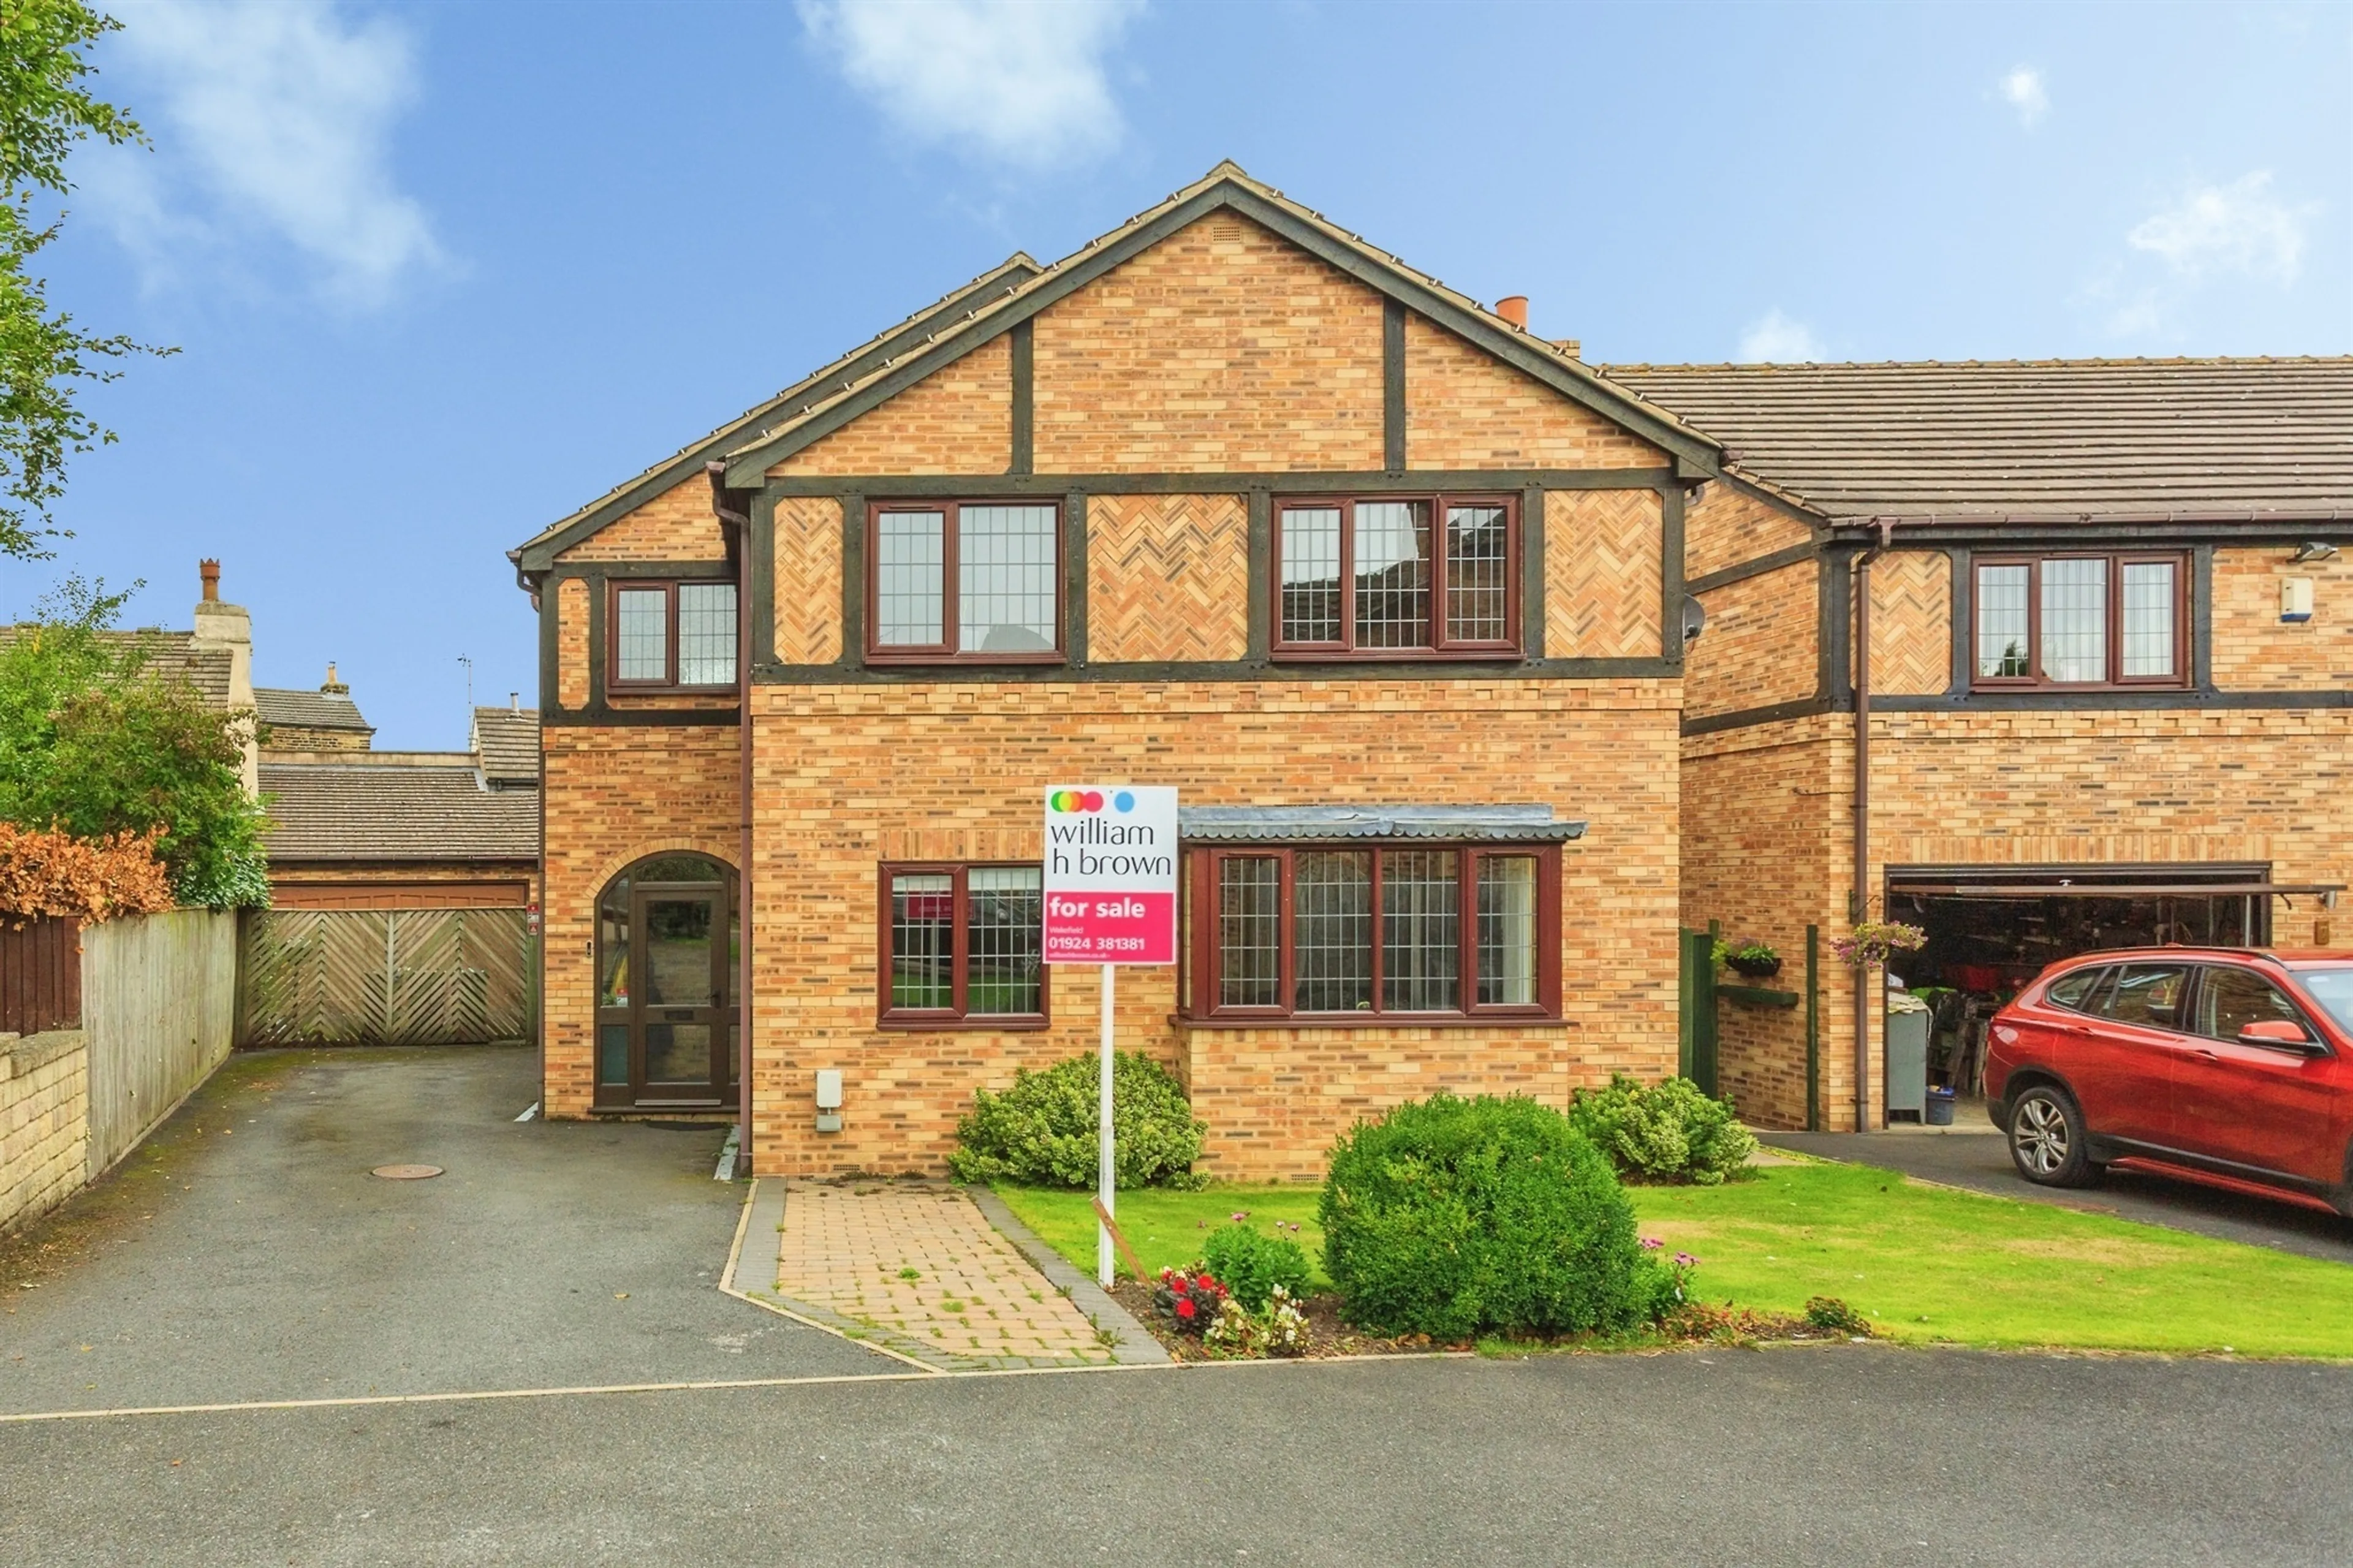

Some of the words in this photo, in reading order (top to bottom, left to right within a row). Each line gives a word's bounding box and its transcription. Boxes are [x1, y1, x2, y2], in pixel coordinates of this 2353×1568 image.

[1051, 817, 1153, 845] william
[1053, 848, 1069, 874] h
[1080, 848, 1170, 875] brown
[1049, 896, 1089, 917] for
[1096, 897, 1145, 918] sale
[1048, 936, 1091, 950] 01924
[1096, 937, 1145, 950] 381381
